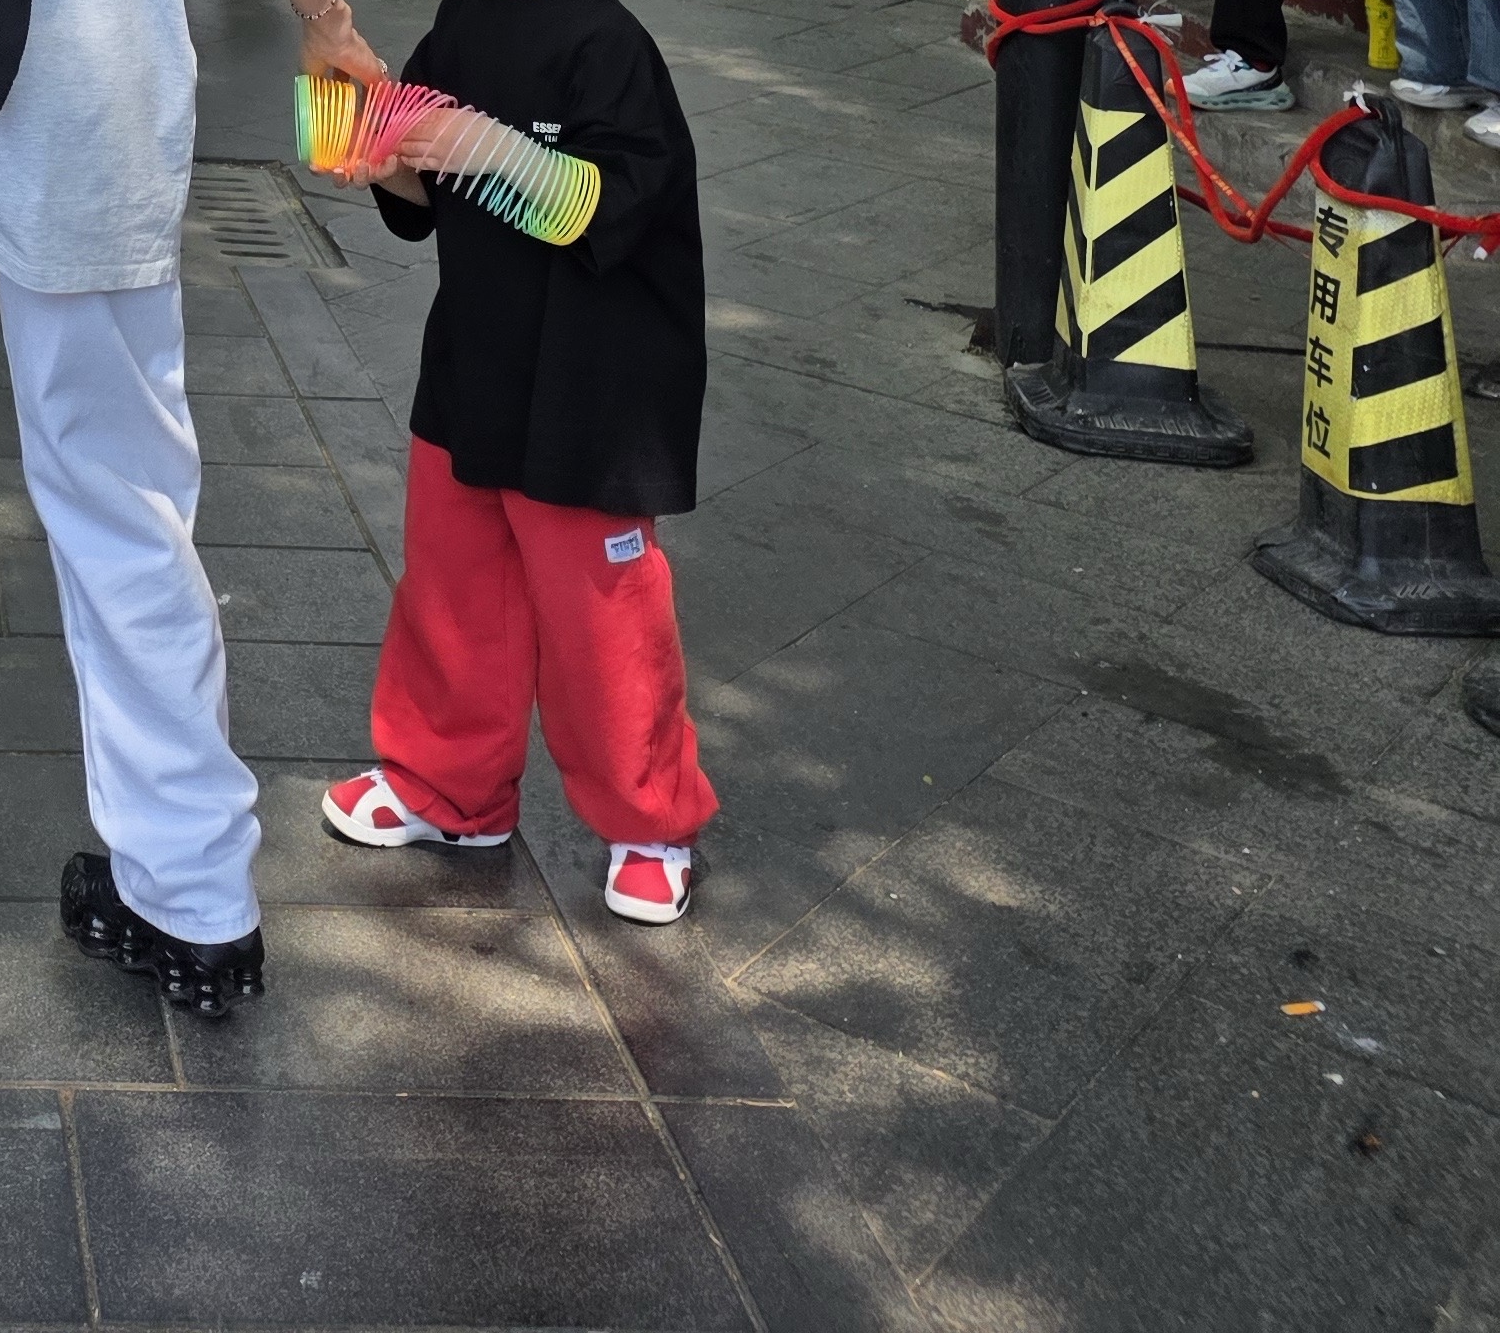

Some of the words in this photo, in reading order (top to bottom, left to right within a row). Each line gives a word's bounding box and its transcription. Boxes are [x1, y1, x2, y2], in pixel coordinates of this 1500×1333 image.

[532, 121, 562, 134] ESSE
[1305, 205, 1349, 460] 专用车位
